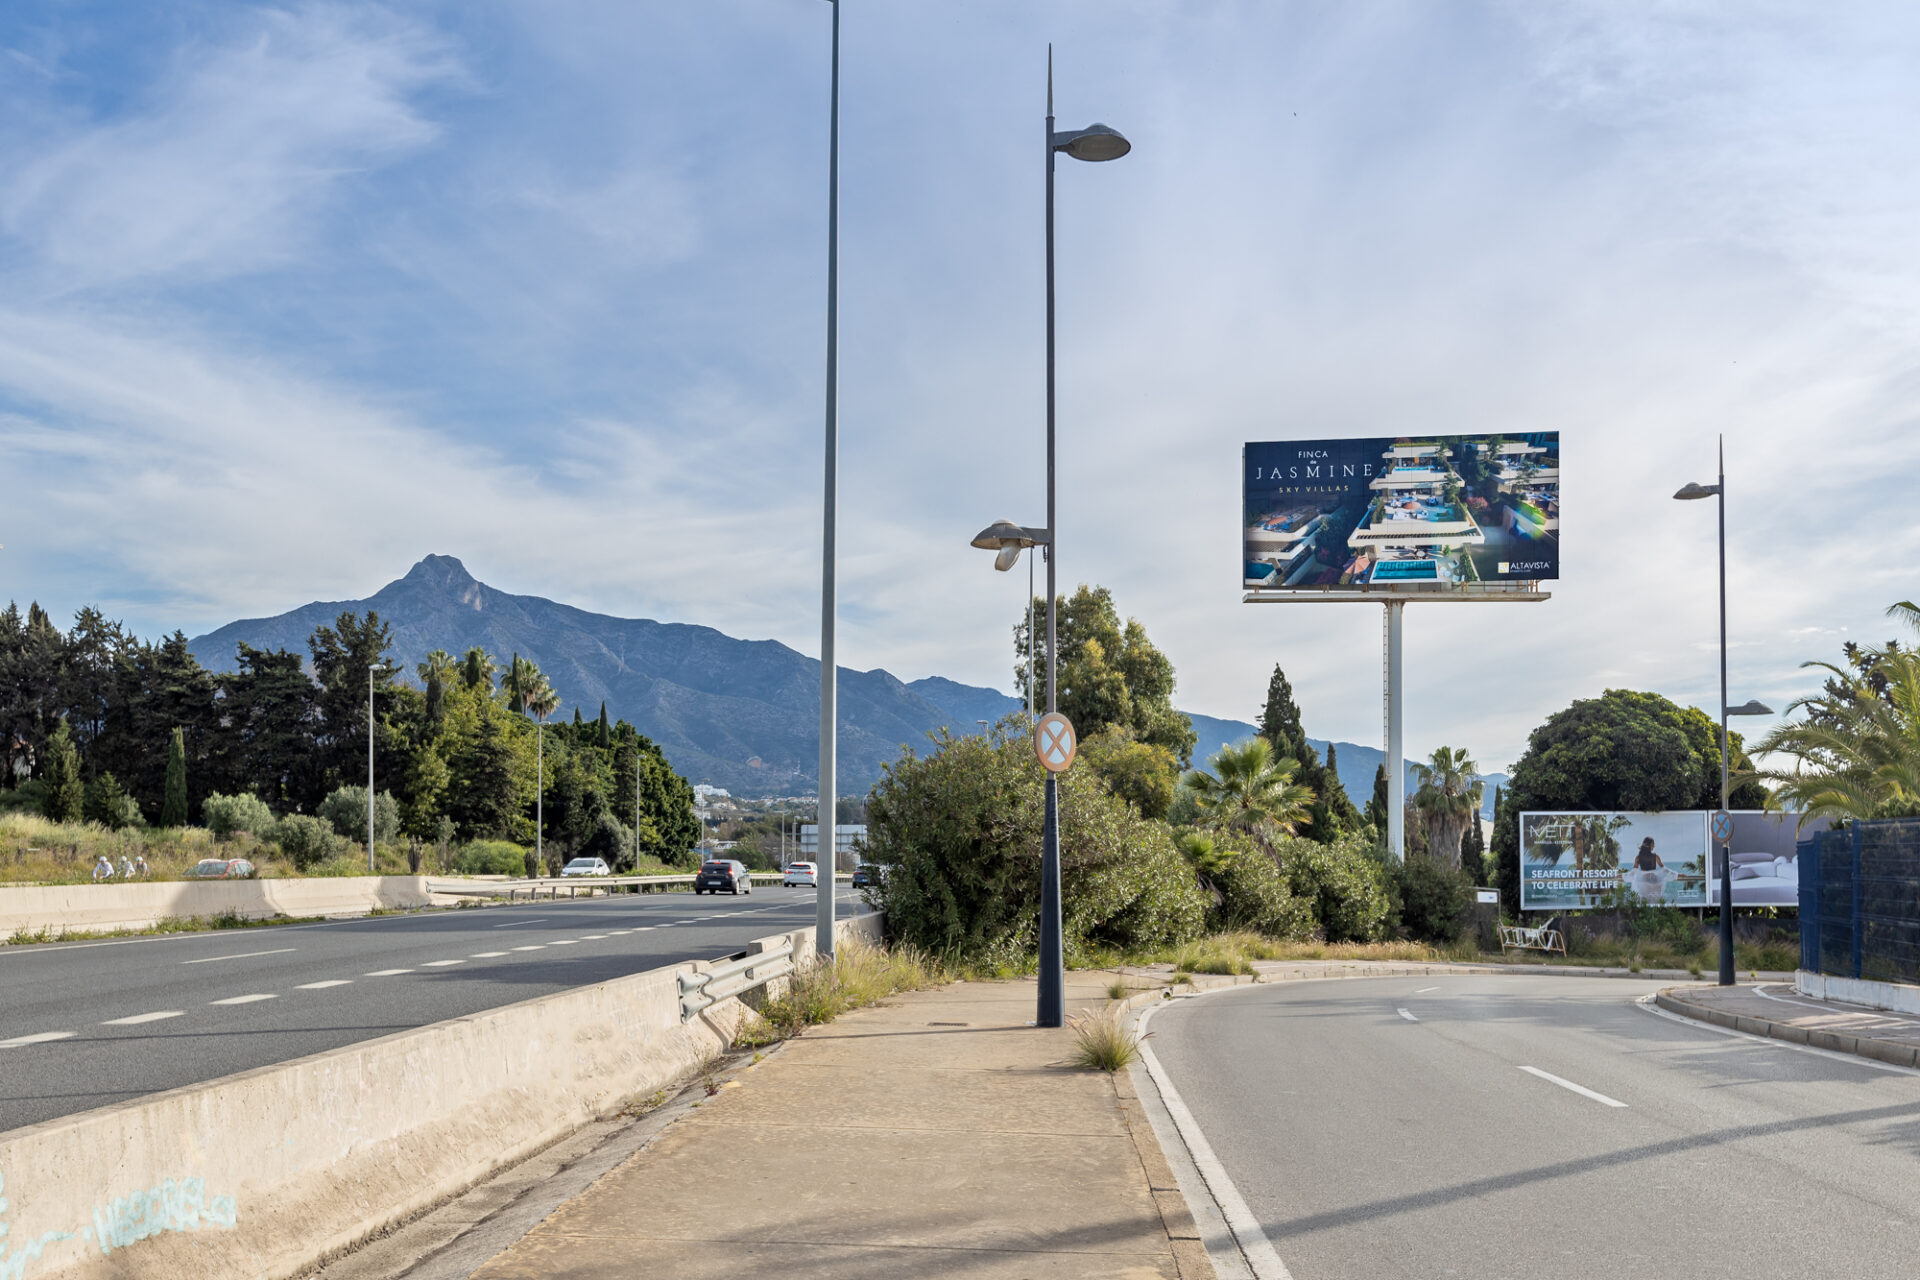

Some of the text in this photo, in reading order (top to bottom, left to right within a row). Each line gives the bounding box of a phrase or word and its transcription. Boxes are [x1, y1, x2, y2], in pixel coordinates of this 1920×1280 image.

[1298, 450, 1329, 458] FINCA
[1256, 464, 1372, 480] JASMINE
[1279, 485, 1349, 494] SKY VILLAS
[1510, 561, 1550, 569] ALTAVISTA
[1531, 868, 1619, 878] SEAFRONT RESORT
[1532, 880, 1619, 889] TO CELEBRATE LIFE
